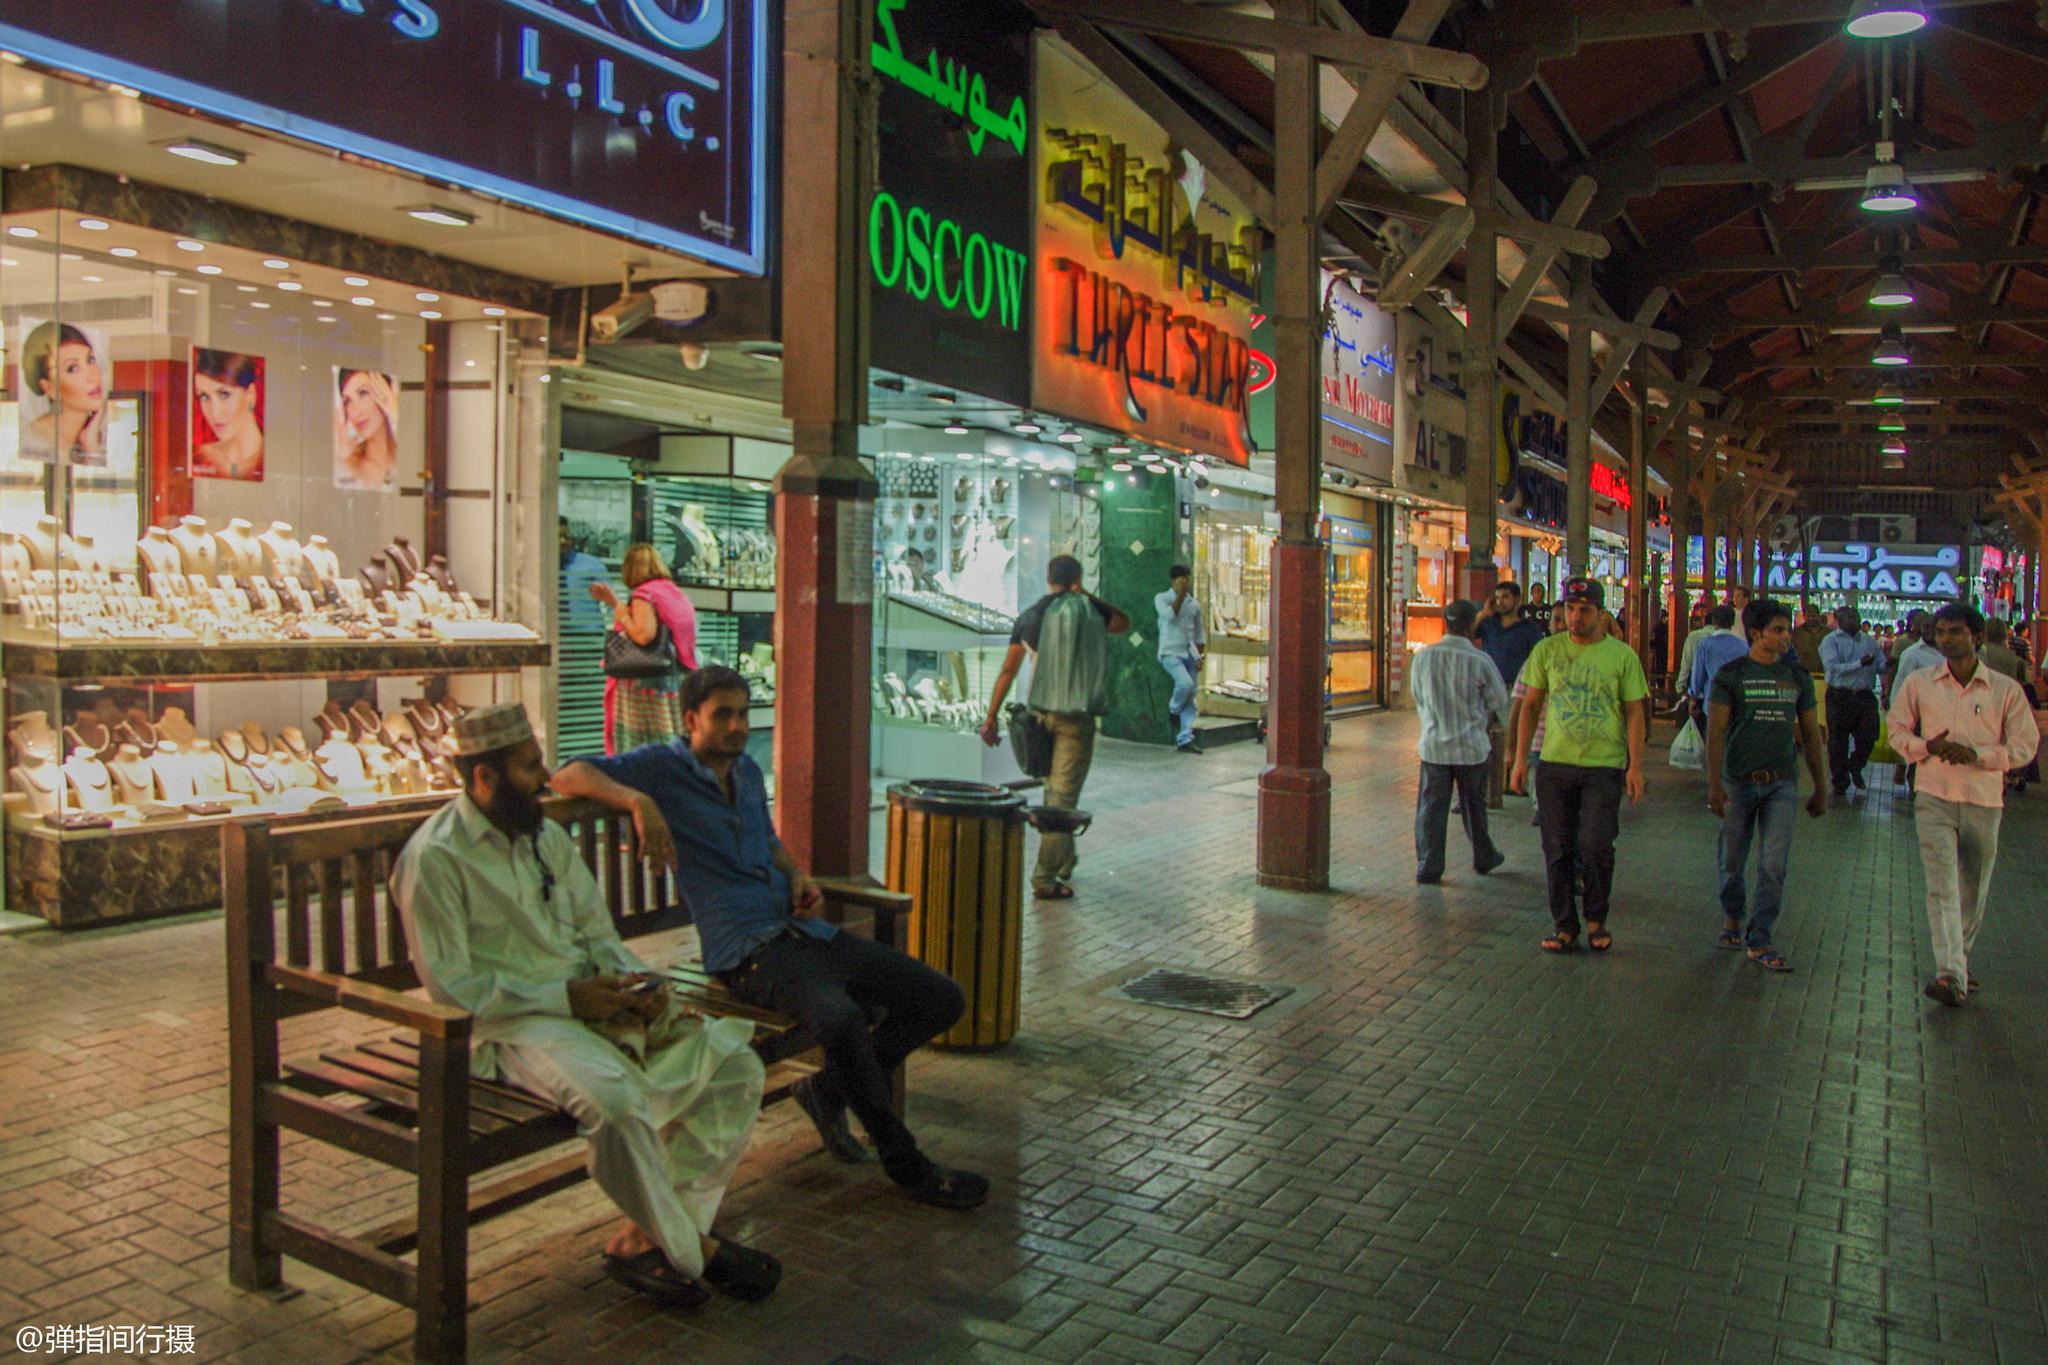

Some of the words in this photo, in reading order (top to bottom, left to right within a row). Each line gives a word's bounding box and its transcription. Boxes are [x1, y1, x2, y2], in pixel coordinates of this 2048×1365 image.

[871, 0, 1027, 156] موسك
[868, 191, 1028, 331] OSCOW
[1753, 566, 1961, 597] MARHABA
